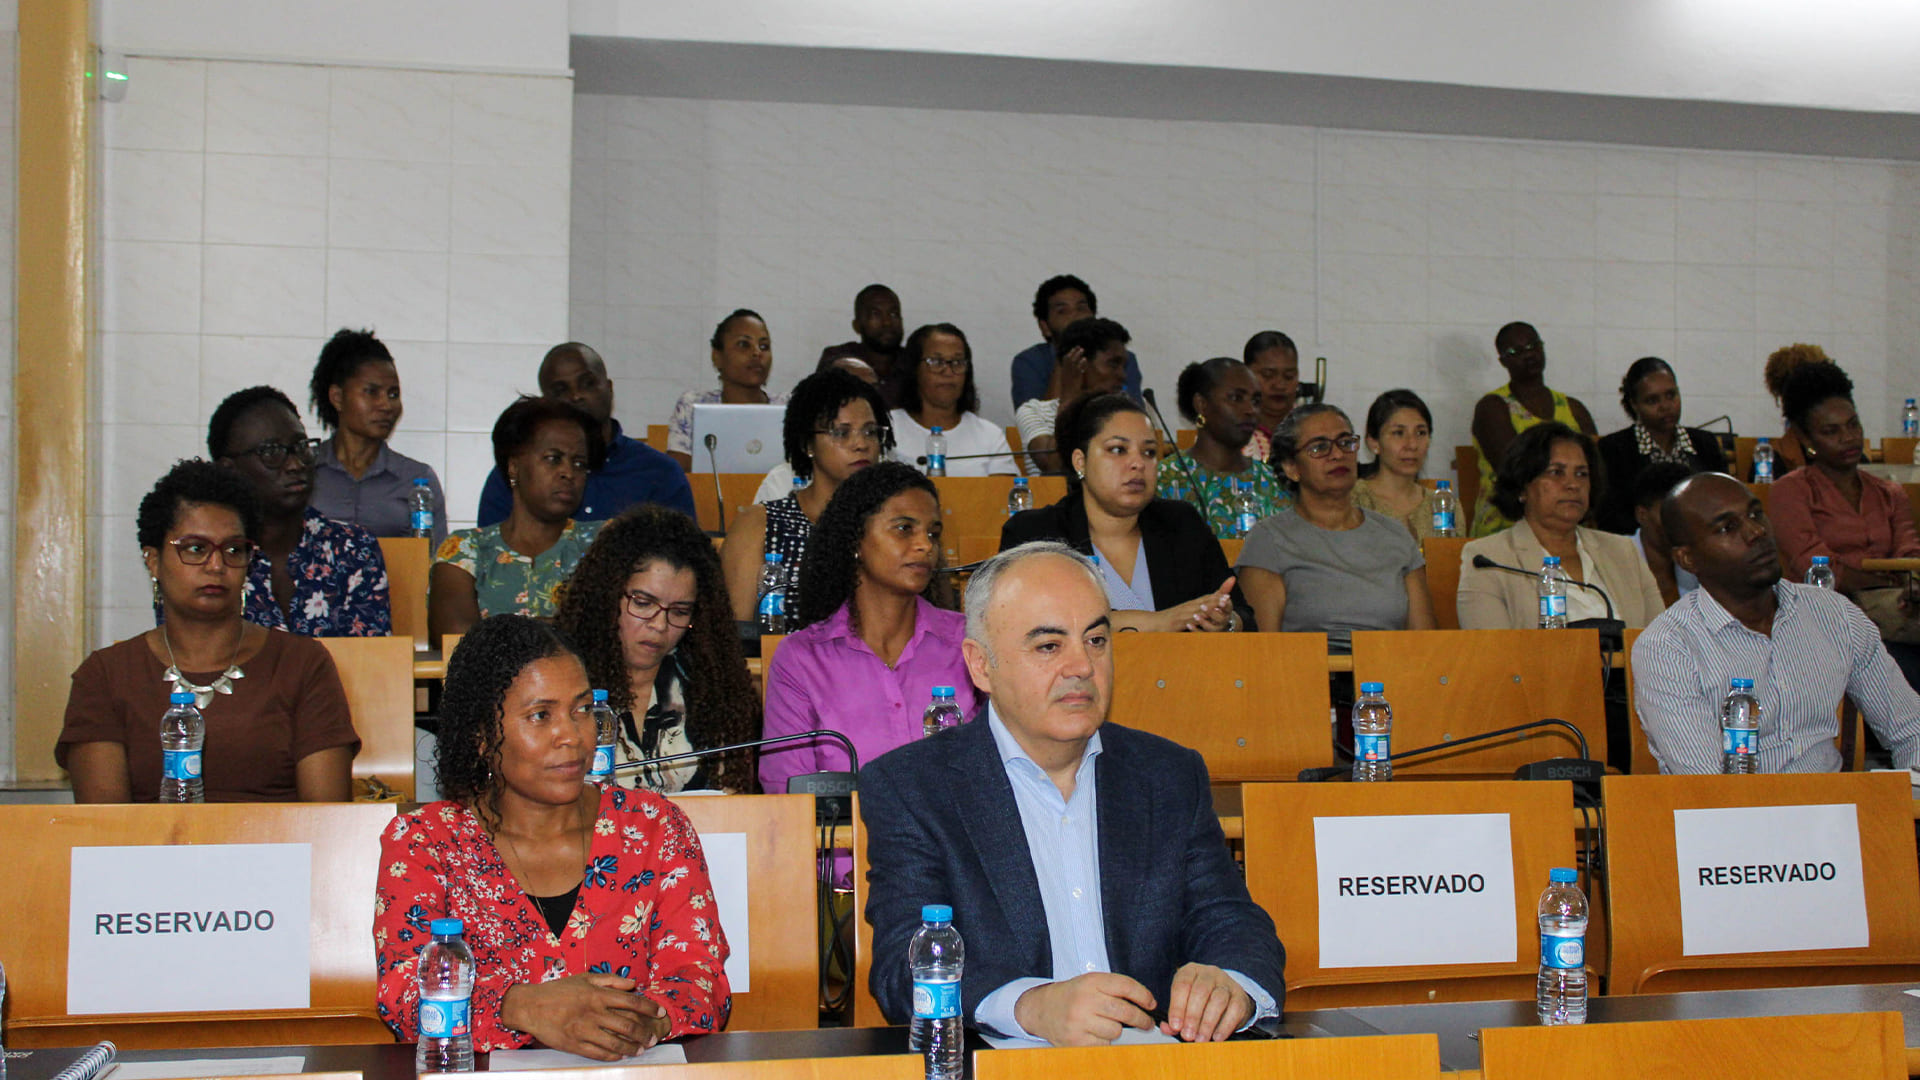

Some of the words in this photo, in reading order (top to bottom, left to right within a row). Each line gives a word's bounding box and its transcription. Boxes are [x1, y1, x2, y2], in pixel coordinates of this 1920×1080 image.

[1546, 766, 1591, 778] BOSCH
[807, 781, 857, 793] BOSCH
[1338, 873, 1485, 897] RESERVADO
[1698, 862, 1837, 887] RESERVADO
[95, 909, 274, 936] RESERVADO
